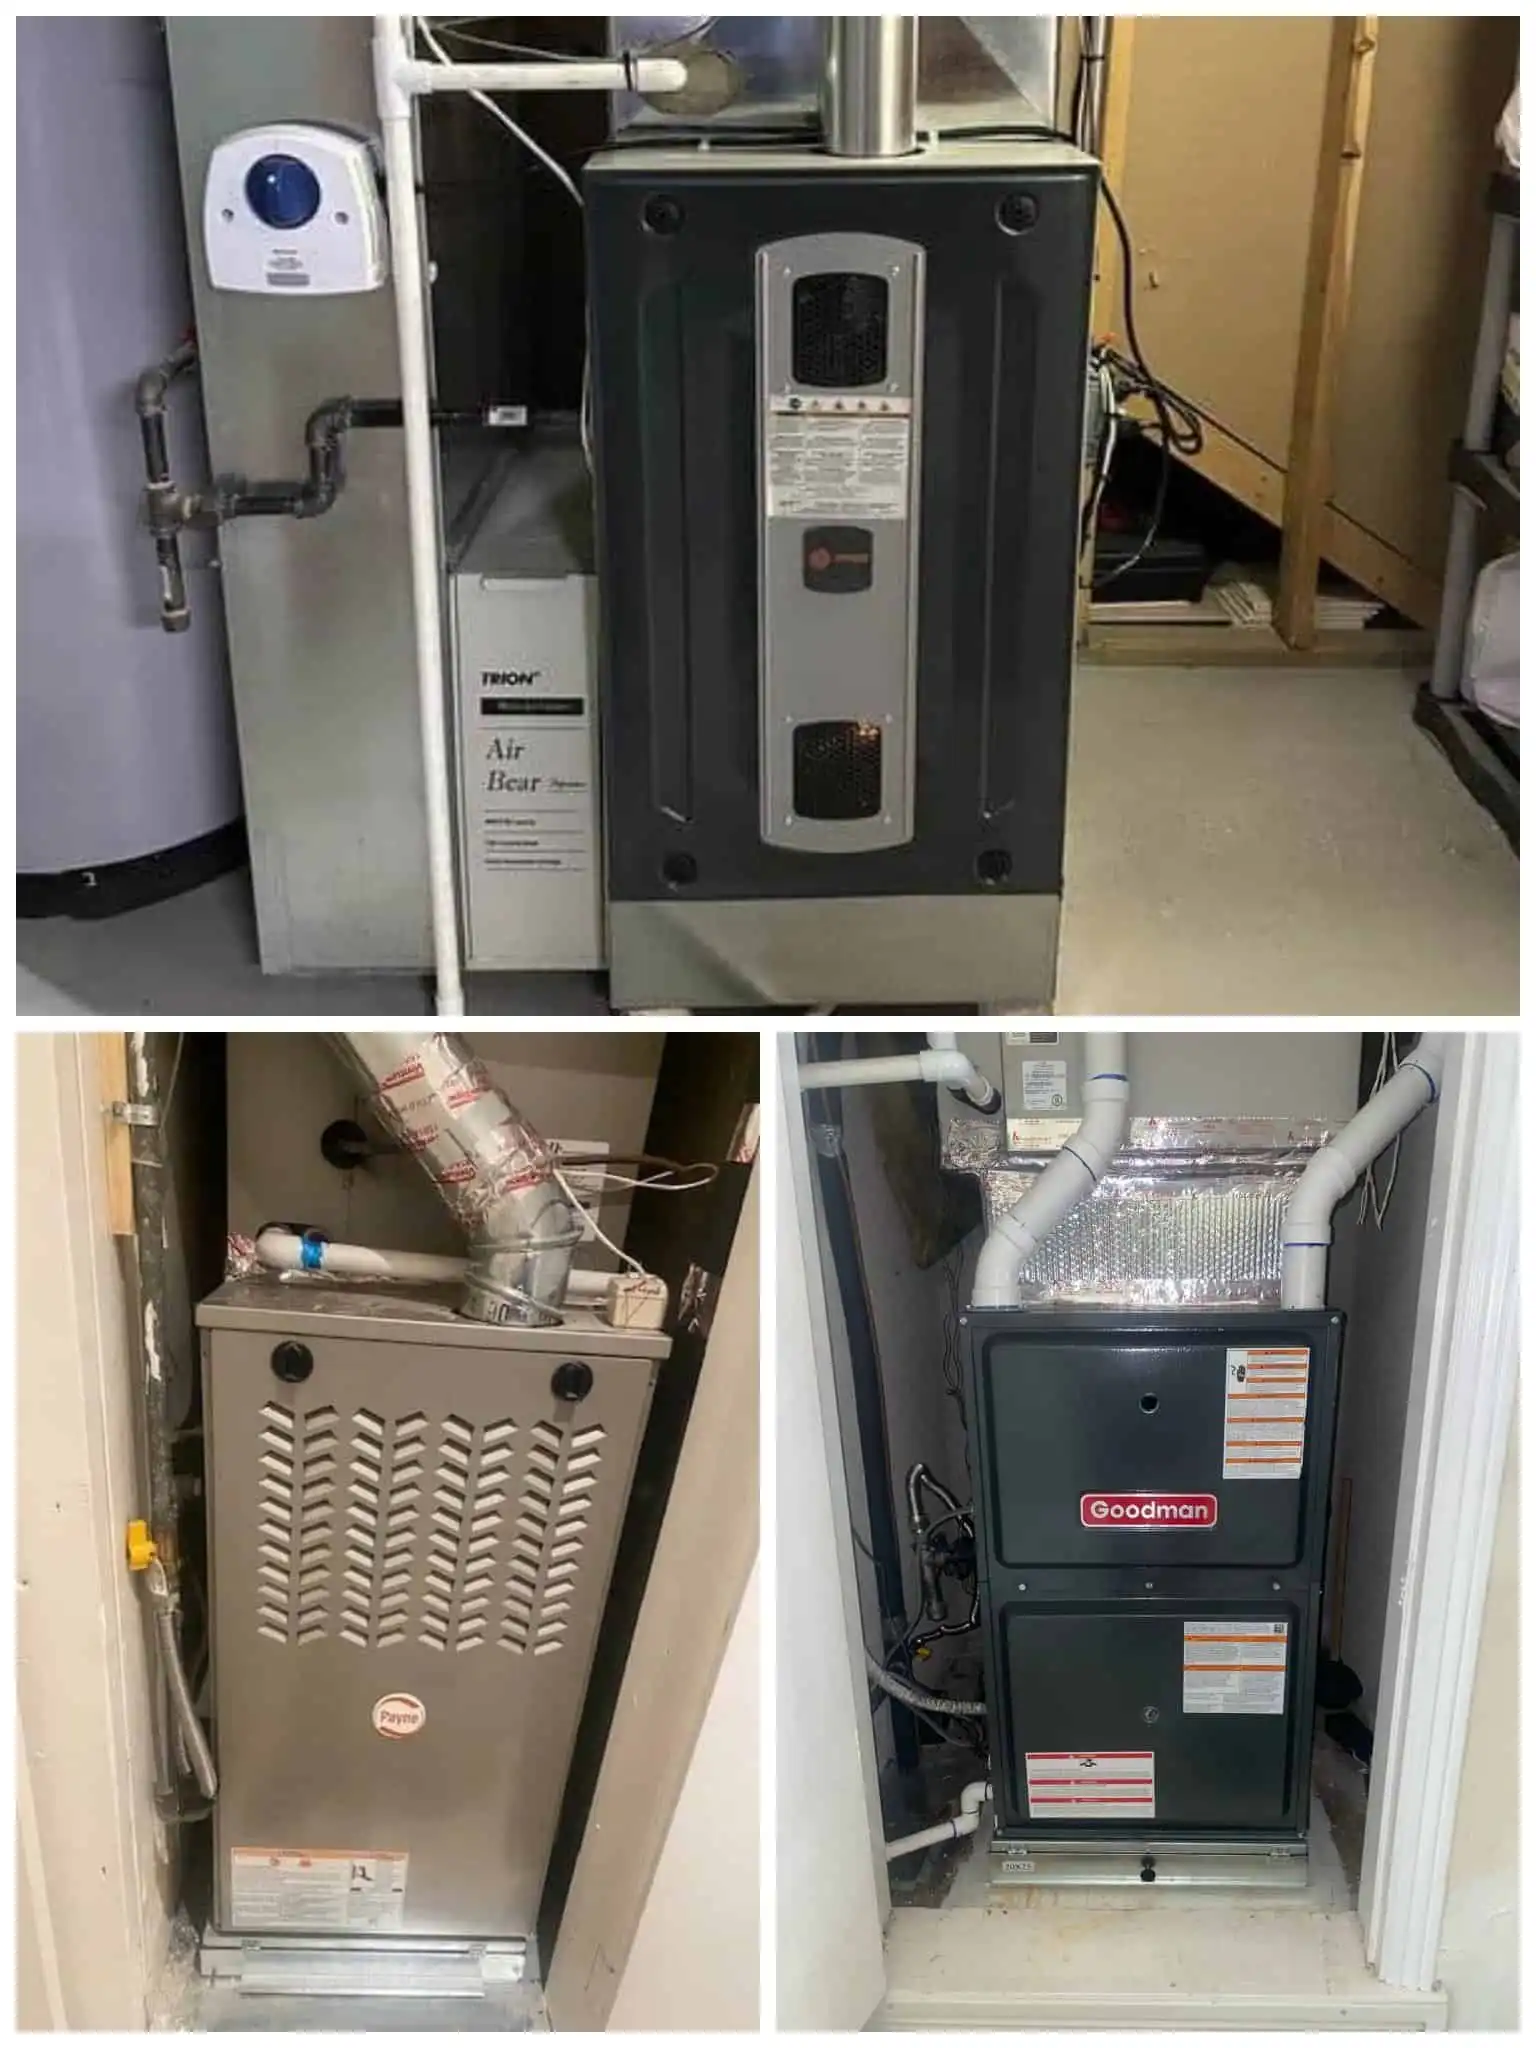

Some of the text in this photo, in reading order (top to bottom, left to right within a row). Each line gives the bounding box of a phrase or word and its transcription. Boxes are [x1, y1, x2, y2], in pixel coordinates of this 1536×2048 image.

[486, 738, 526, 760] Air
[487, 769, 541, 793] Bear
[1090, 1500, 1208, 1519] Goodman
[380, 1709, 419, 1725] Payne
